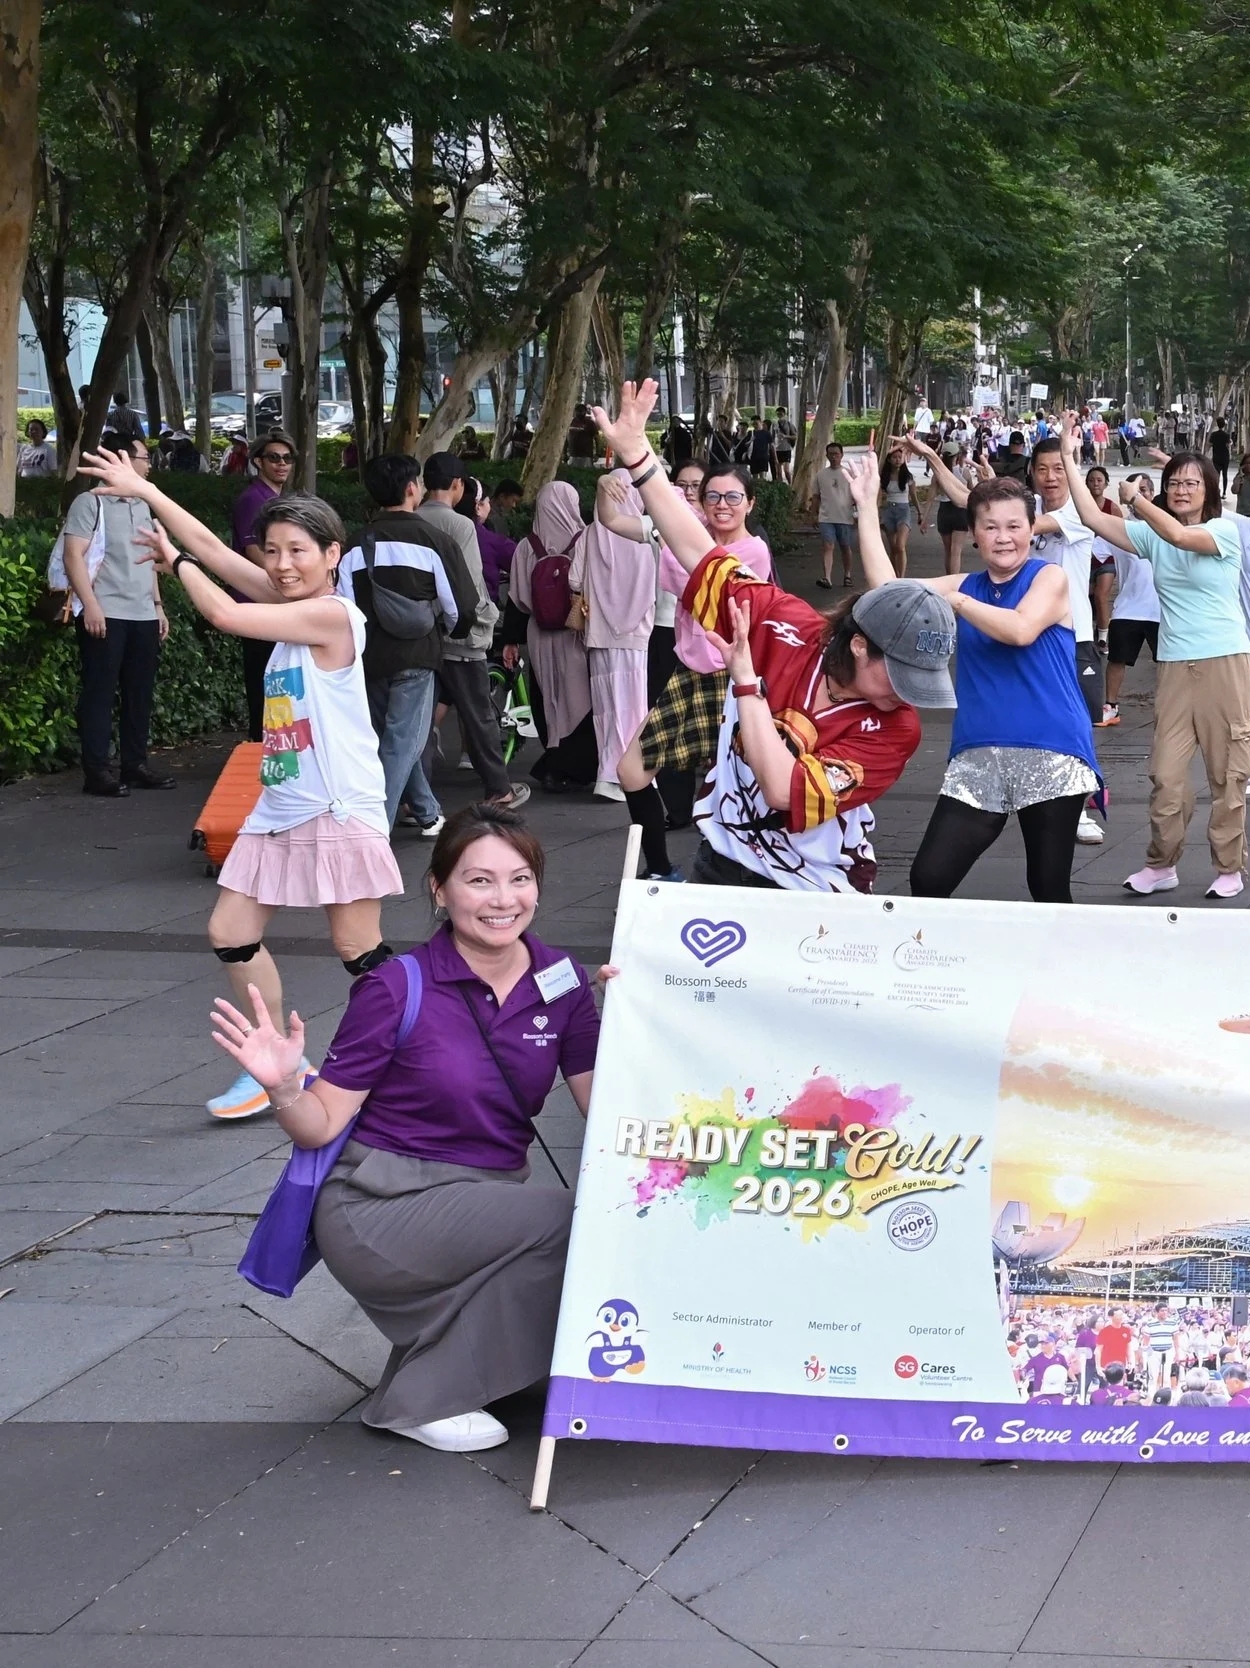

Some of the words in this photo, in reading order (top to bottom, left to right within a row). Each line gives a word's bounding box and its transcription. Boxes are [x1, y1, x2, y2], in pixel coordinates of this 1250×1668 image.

[805, 946, 877, 958] TRANSPARENCY
[843, 943, 879, 951] CHARITY
[826, 955, 859, 963] AWARDS
[904, 953, 967, 964] TRANSPARENCY
[664, 974, 711, 987] Blossom
[714, 976, 748, 988] Seeds
[788, 986, 821, 994] Certificate
[614, 1116, 751, 1166] READY
[760, 1129, 837, 1170] SET
[843, 1123, 983, 1180] Gold!
[731, 1176, 853, 1218] 2026
[870, 1184, 900, 1201] CHOPE,
[901, 1181, 917, 1190] Age
[891, 1215, 933, 1238] CHOPE
[672, 1311, 704, 1323] Sector
[706, 1314, 774, 1327] Administrator
[808, 1321, 848, 1331] Member
[851, 1323, 862, 1332] of
[908, 1325, 952, 1336] Operator
[954, 1326, 965, 1336] of
[683, 1363, 714, 1372] MINISTRY
[726, 1367, 752, 1375] HEALTH
[829, 1365, 857, 1375] NCSS
[897, 1361, 915, 1373] SG
[921, 1363, 956, 1374] Cares
[951, 1415, 985, 1443] To
[995, 1420, 1072, 1445] Serve
[1081, 1420, 1139, 1446] with
[1145, 1420, 1209, 1447] Love
